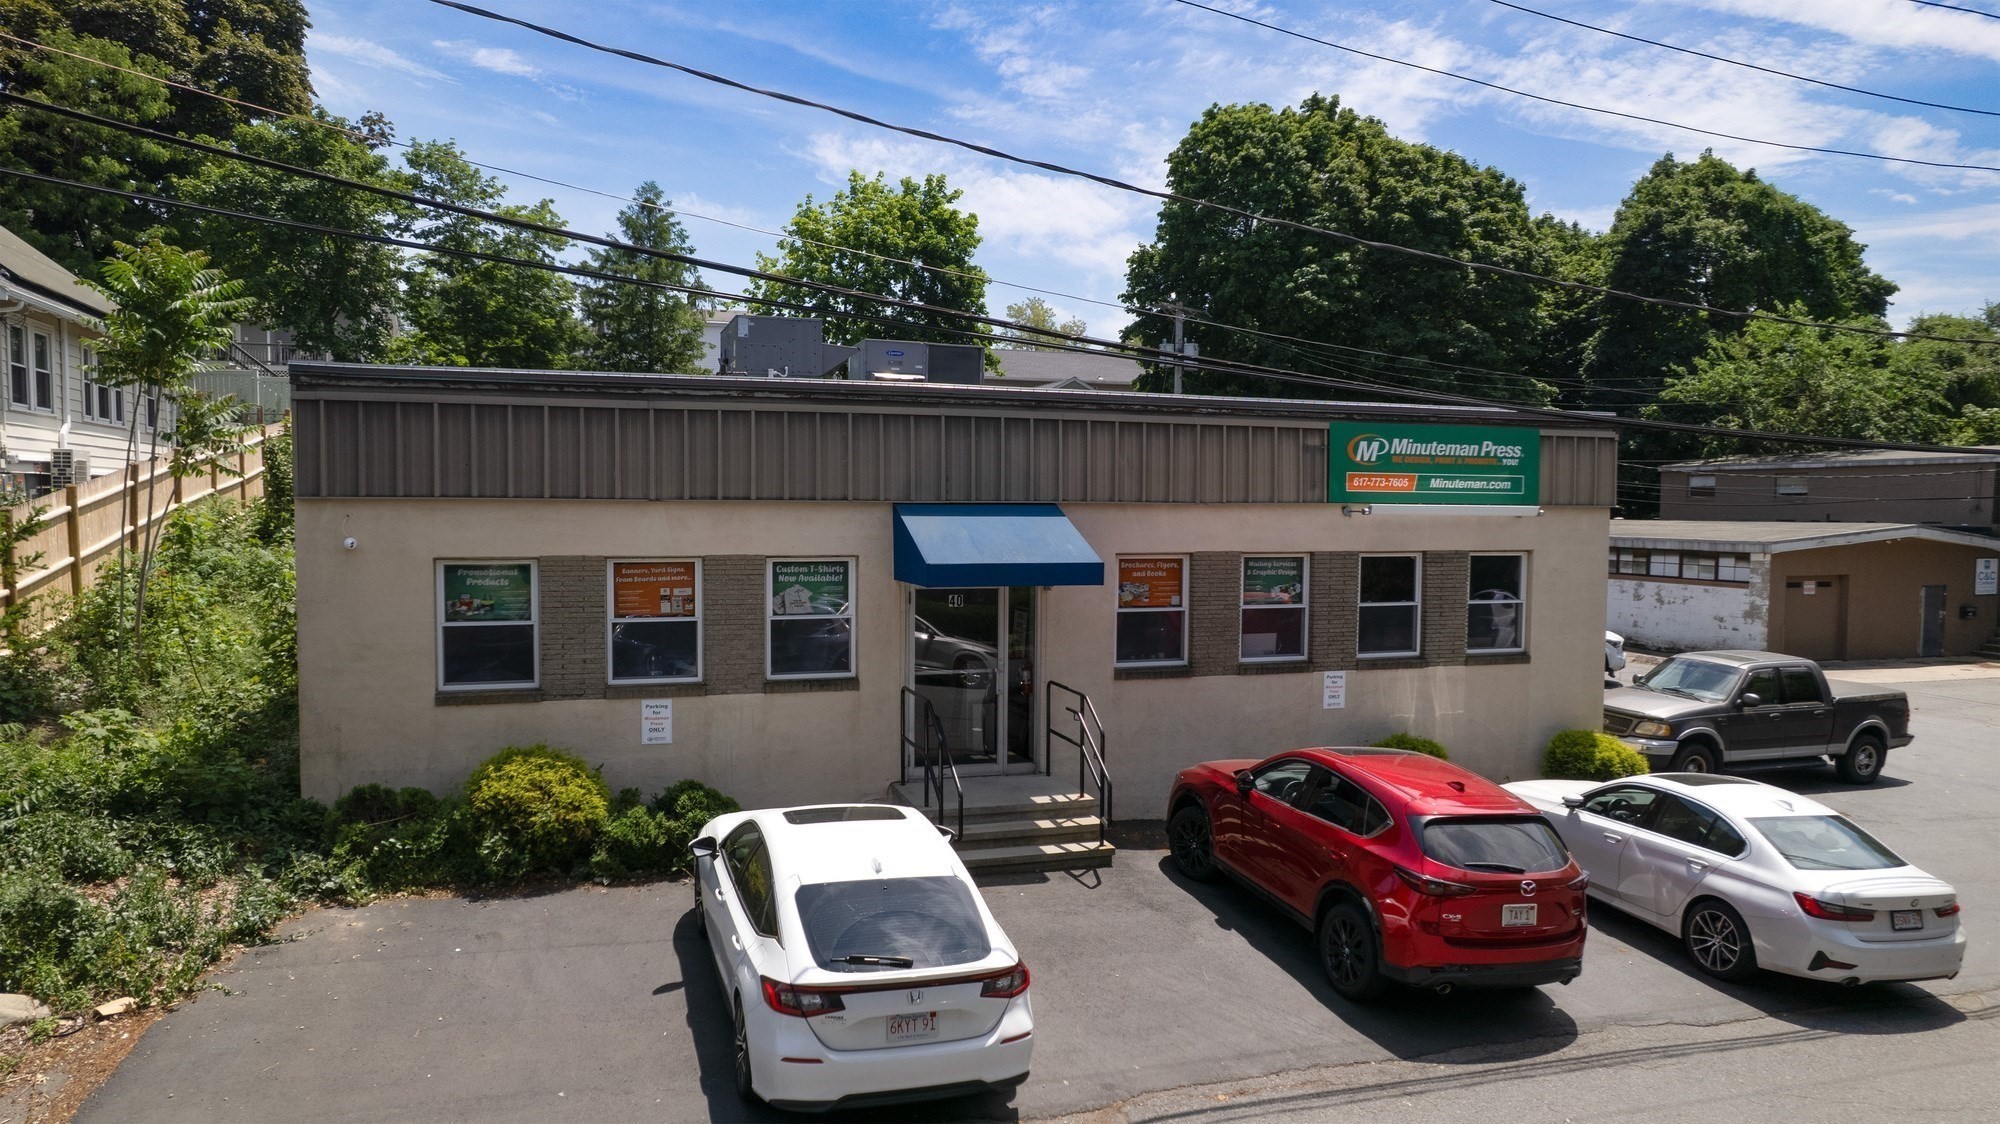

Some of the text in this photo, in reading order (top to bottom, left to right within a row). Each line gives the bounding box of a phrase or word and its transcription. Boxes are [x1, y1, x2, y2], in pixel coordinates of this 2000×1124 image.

[1390, 438, 1479, 456] Minuteman
[1353, 477, 1512, 489] 617-773-7605 Minuteman.com
[457, 568, 519, 576] Promotional
[776, 565, 844, 573] Custom T-Shirts
[778, 574, 843, 582] Now Available!
[1977, 571, 1996, 580] C&C
[466, 578, 510, 586] Products
[949, 595, 963, 607] 40
[1509, 909, 1523, 920] TAY
[890, 1018, 918, 1034] 6KYT
[922, 1016, 936, 1031] 91
